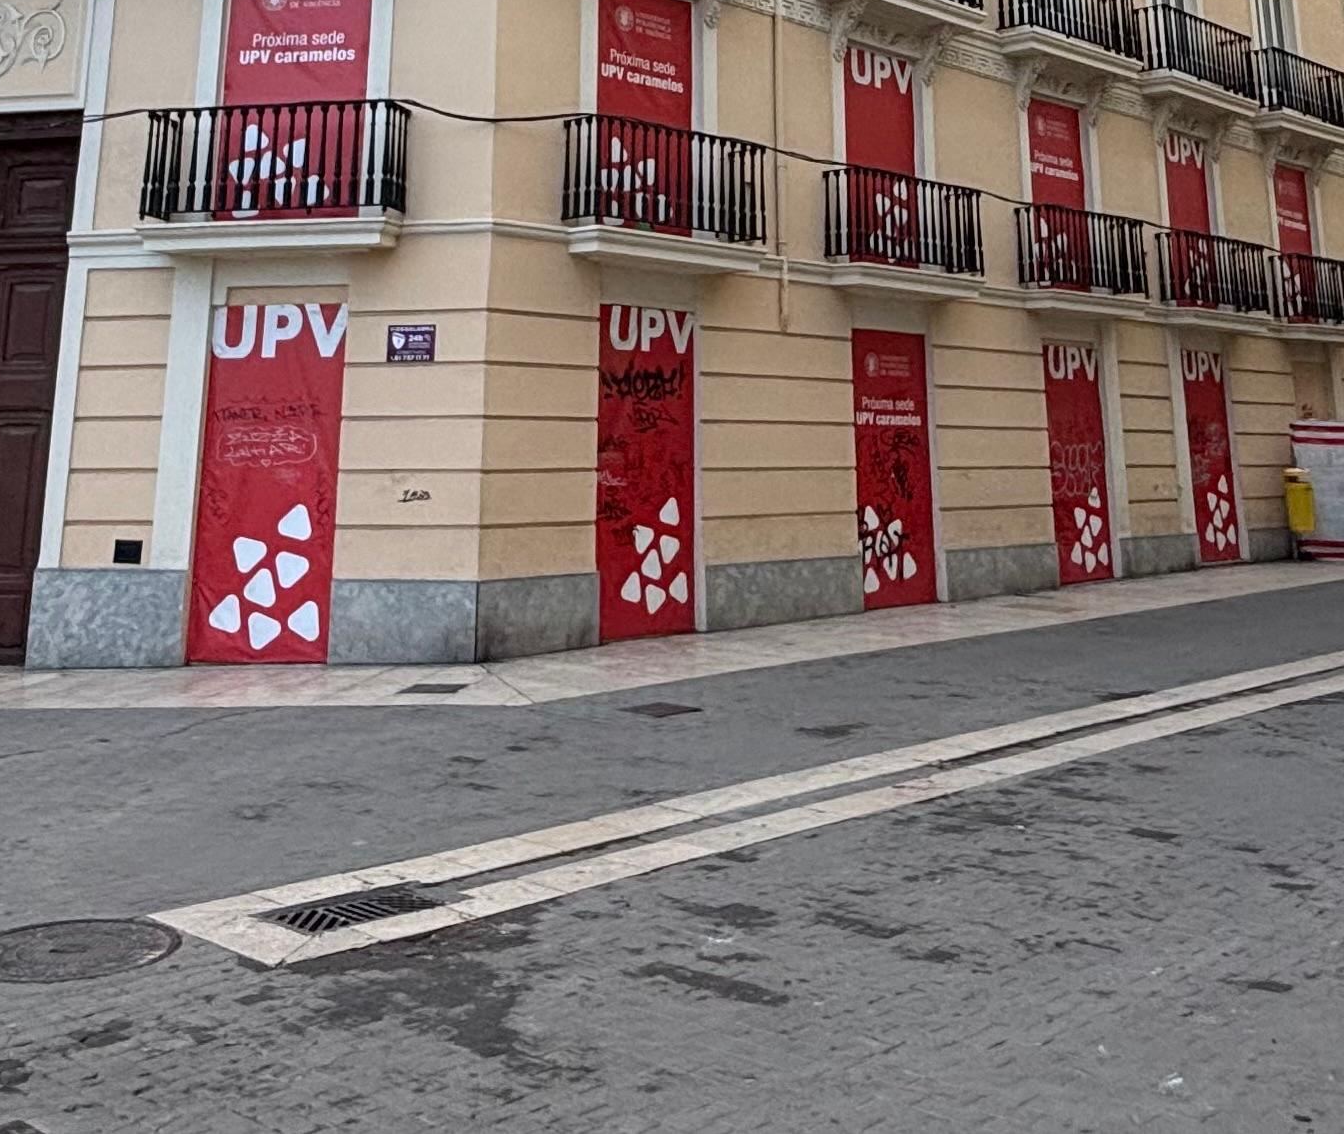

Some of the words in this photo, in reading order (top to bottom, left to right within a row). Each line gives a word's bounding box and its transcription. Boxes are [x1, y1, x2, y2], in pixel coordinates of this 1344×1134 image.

[252, 32, 307, 47] Próxima
[311, 30, 345, 45] sede
[239, 49, 271, 65] UPV
[274, 47, 356, 64] caramelos
[610, 48, 651, 71] Próxima
[652, 60, 676, 76] sede
[851, 48, 912, 95] UPV
[601, 63, 625, 80] UPV
[626, 69, 684, 94] caramelos
[1166, 134, 1204, 170] UPV
[212, 303, 348, 359] UPV
[609, 306, 695, 355] UPV
[1047, 345, 1096, 382] UPV
[1182, 350, 1221, 383] UPV
[856, 411, 874, 425] UPV
